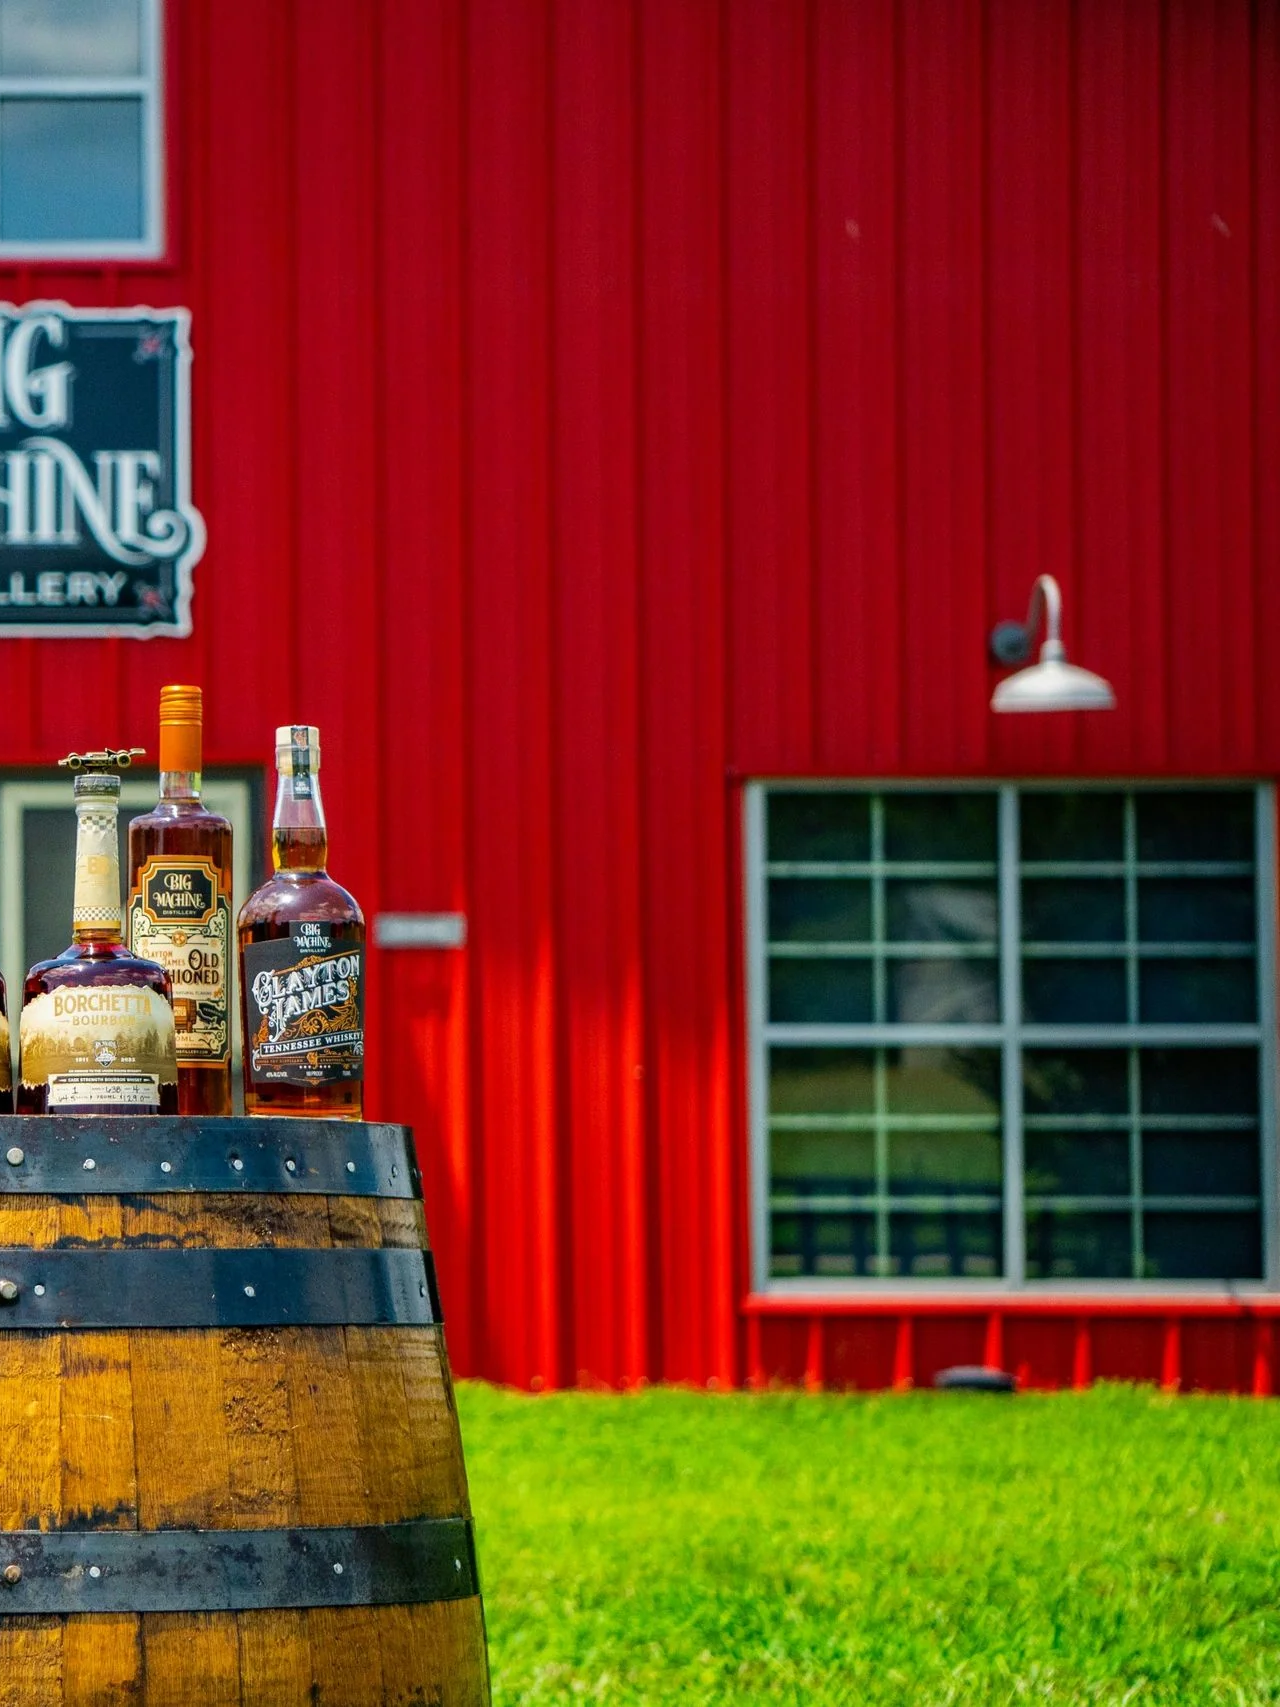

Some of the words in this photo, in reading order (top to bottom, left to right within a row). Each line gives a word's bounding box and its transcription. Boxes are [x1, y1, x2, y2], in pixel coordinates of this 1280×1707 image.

[164, 873, 193, 890] BIG
[152, 891, 205, 909] MACHINE
[300, 923, 321, 936] BIG
[293, 936, 332, 948] MACHINE
[189, 949, 219, 970] OLD
[169, 969, 219, 985] HIONED
[252, 955, 360, 1014] CLAYTON
[54, 994, 152, 1017] BORCHETTA
[269, 980, 350, 1042] JAMES
[72, 1015, 137, 1026] BOURBON
[263, 1038, 322, 1054] TENNESSEE
